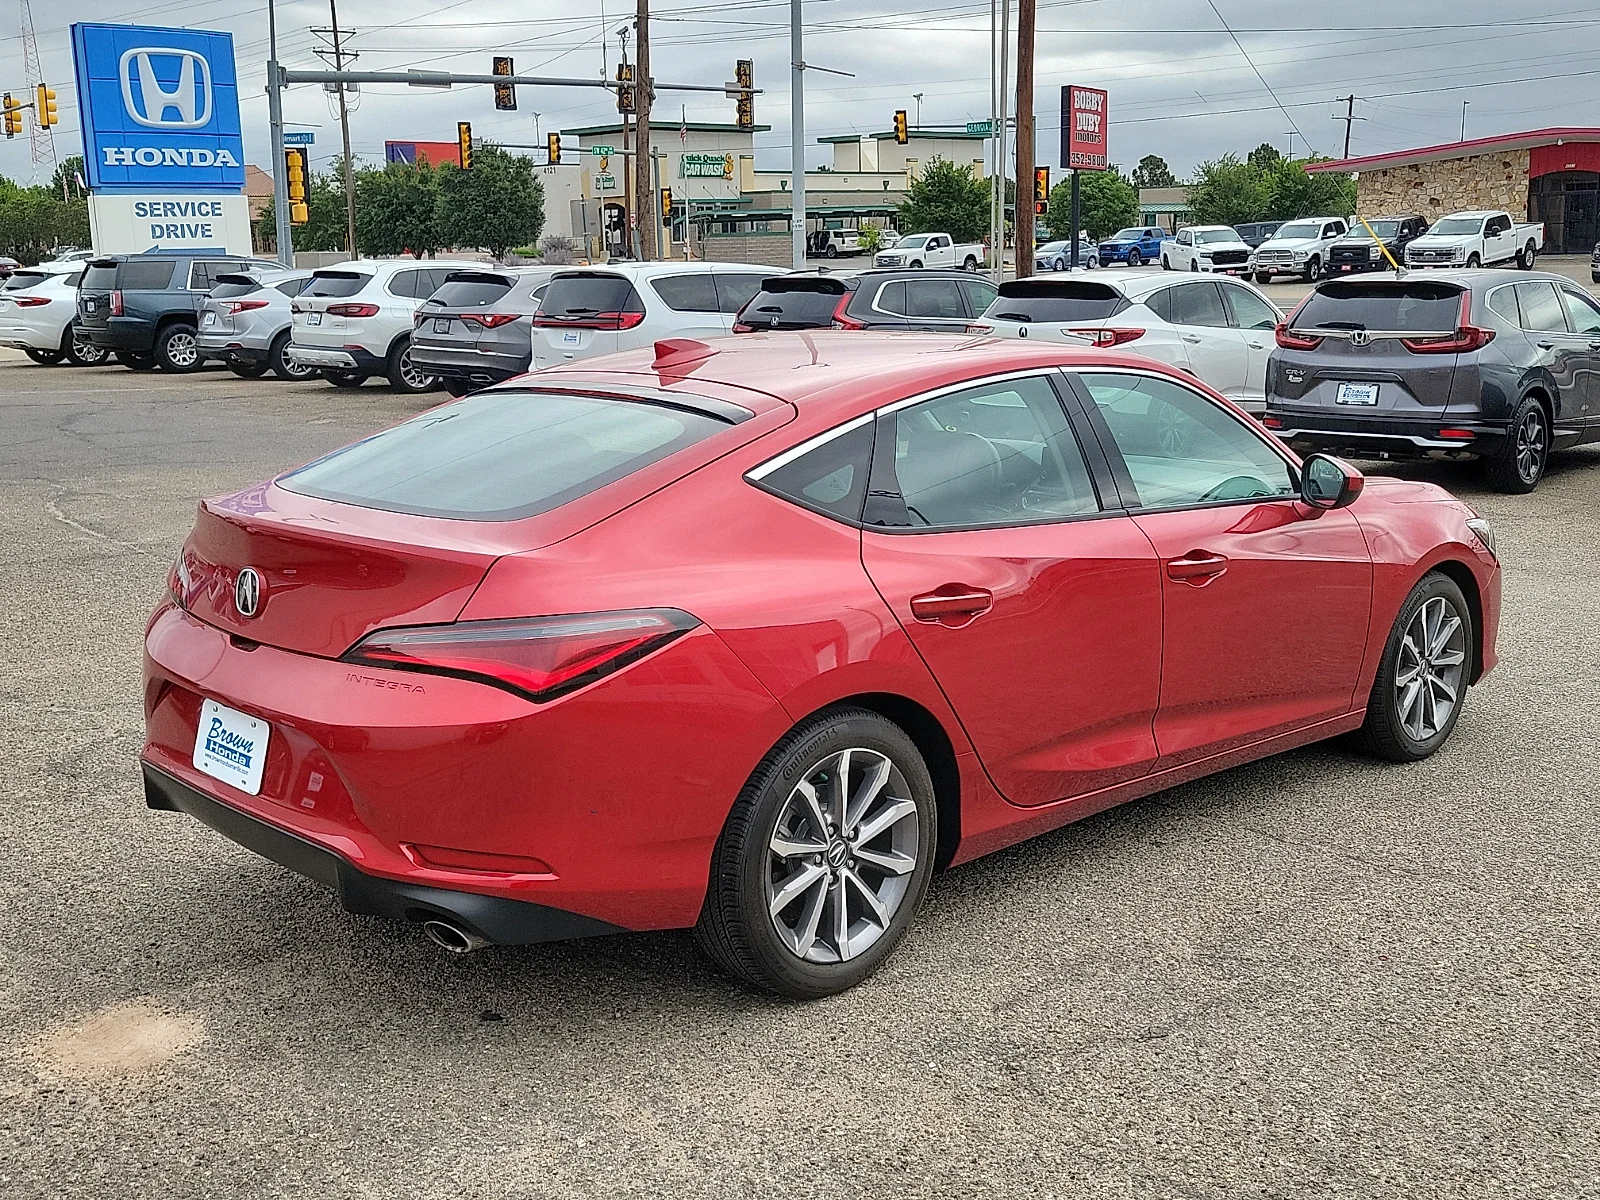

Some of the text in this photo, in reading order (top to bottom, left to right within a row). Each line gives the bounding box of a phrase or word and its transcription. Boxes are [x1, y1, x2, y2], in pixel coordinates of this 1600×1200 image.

[1073, 90, 1104, 112] BOBBY
[1075, 112, 1101, 132] DUBY
[1075, 131, 1102, 143] motors
[102, 147, 240, 167] HONDA
[702, 154, 724, 163] Quack
[1071, 152, 1105, 167] 352-9800
[543, 166, 556, 174] 4121
[685, 163, 724, 176] CAR WASH
[134, 201, 223, 218] SERVICE
[150, 223, 213, 240] DRIVE
[345, 673, 426, 695] INTEGRA
[208, 717, 254, 753] Brown
[209, 742, 247, 767] Honda
[783, 730, 830, 780] Continental
